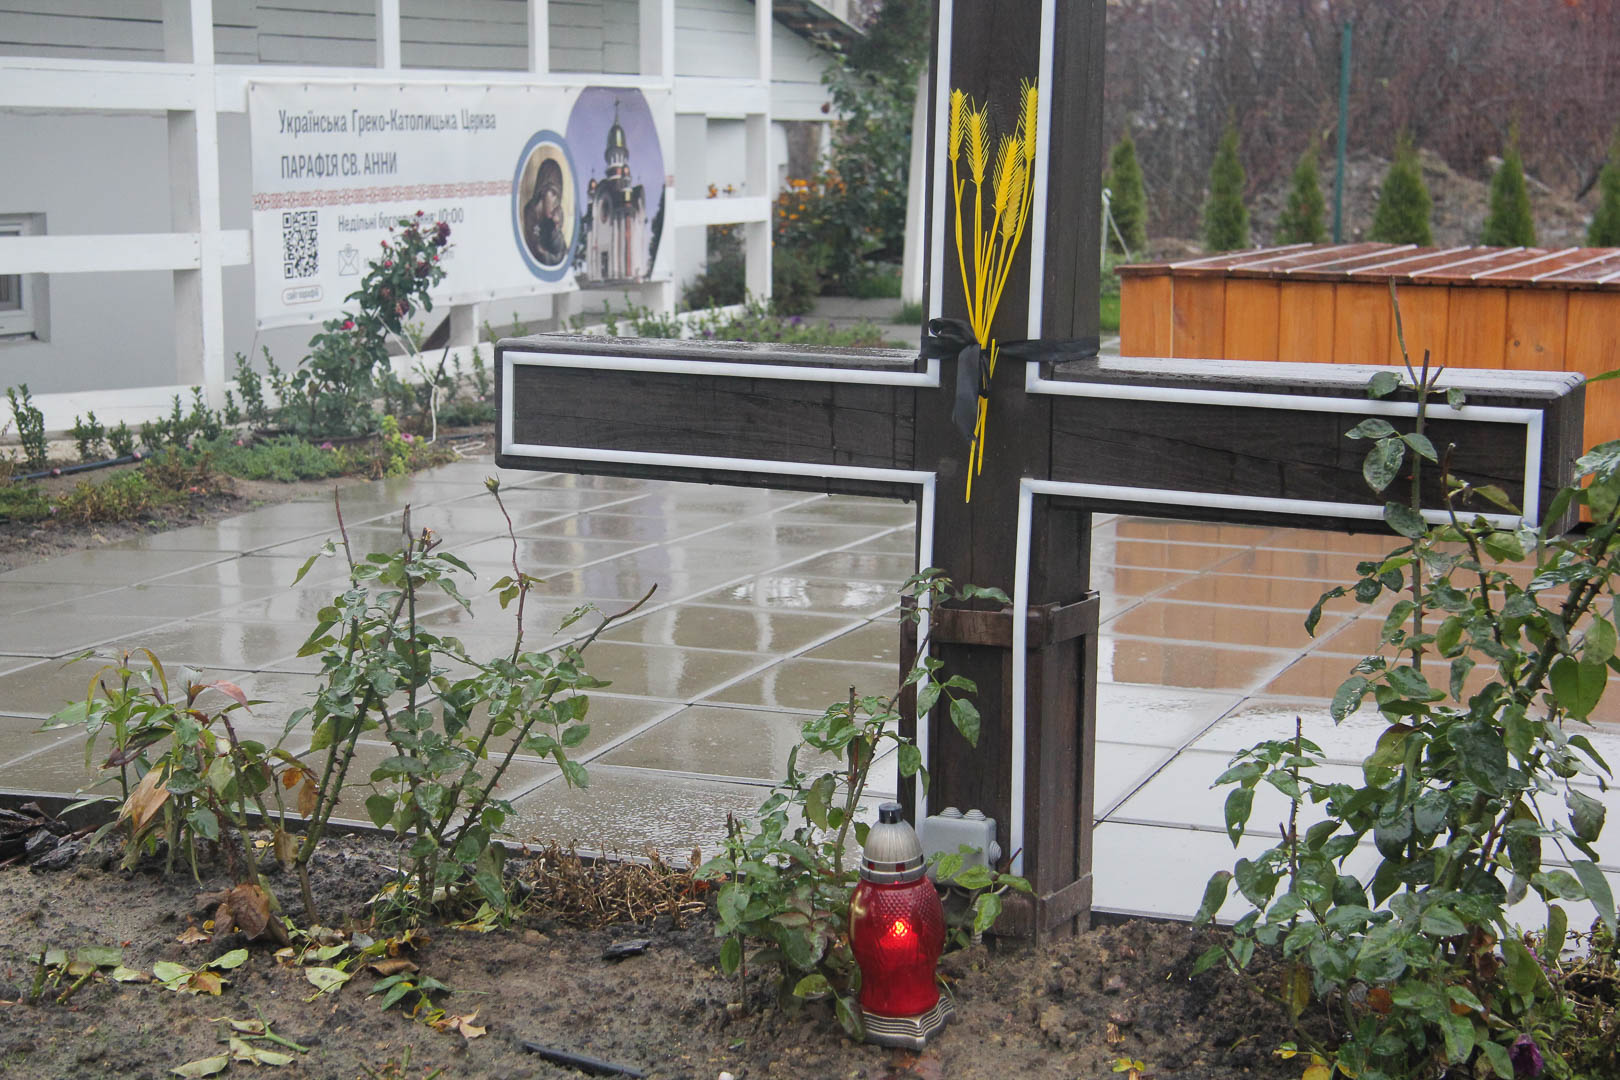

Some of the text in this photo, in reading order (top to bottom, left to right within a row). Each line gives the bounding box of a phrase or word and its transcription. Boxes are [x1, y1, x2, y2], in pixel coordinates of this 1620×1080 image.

[278, 108, 496, 138] Українська Греко-Католицька Церква
[281, 151, 398, 179] ПАРАФІЯ СВ. АННИ
[338, 212, 377, 232] Недільні
[439, 207, 464, 224] 10:00
